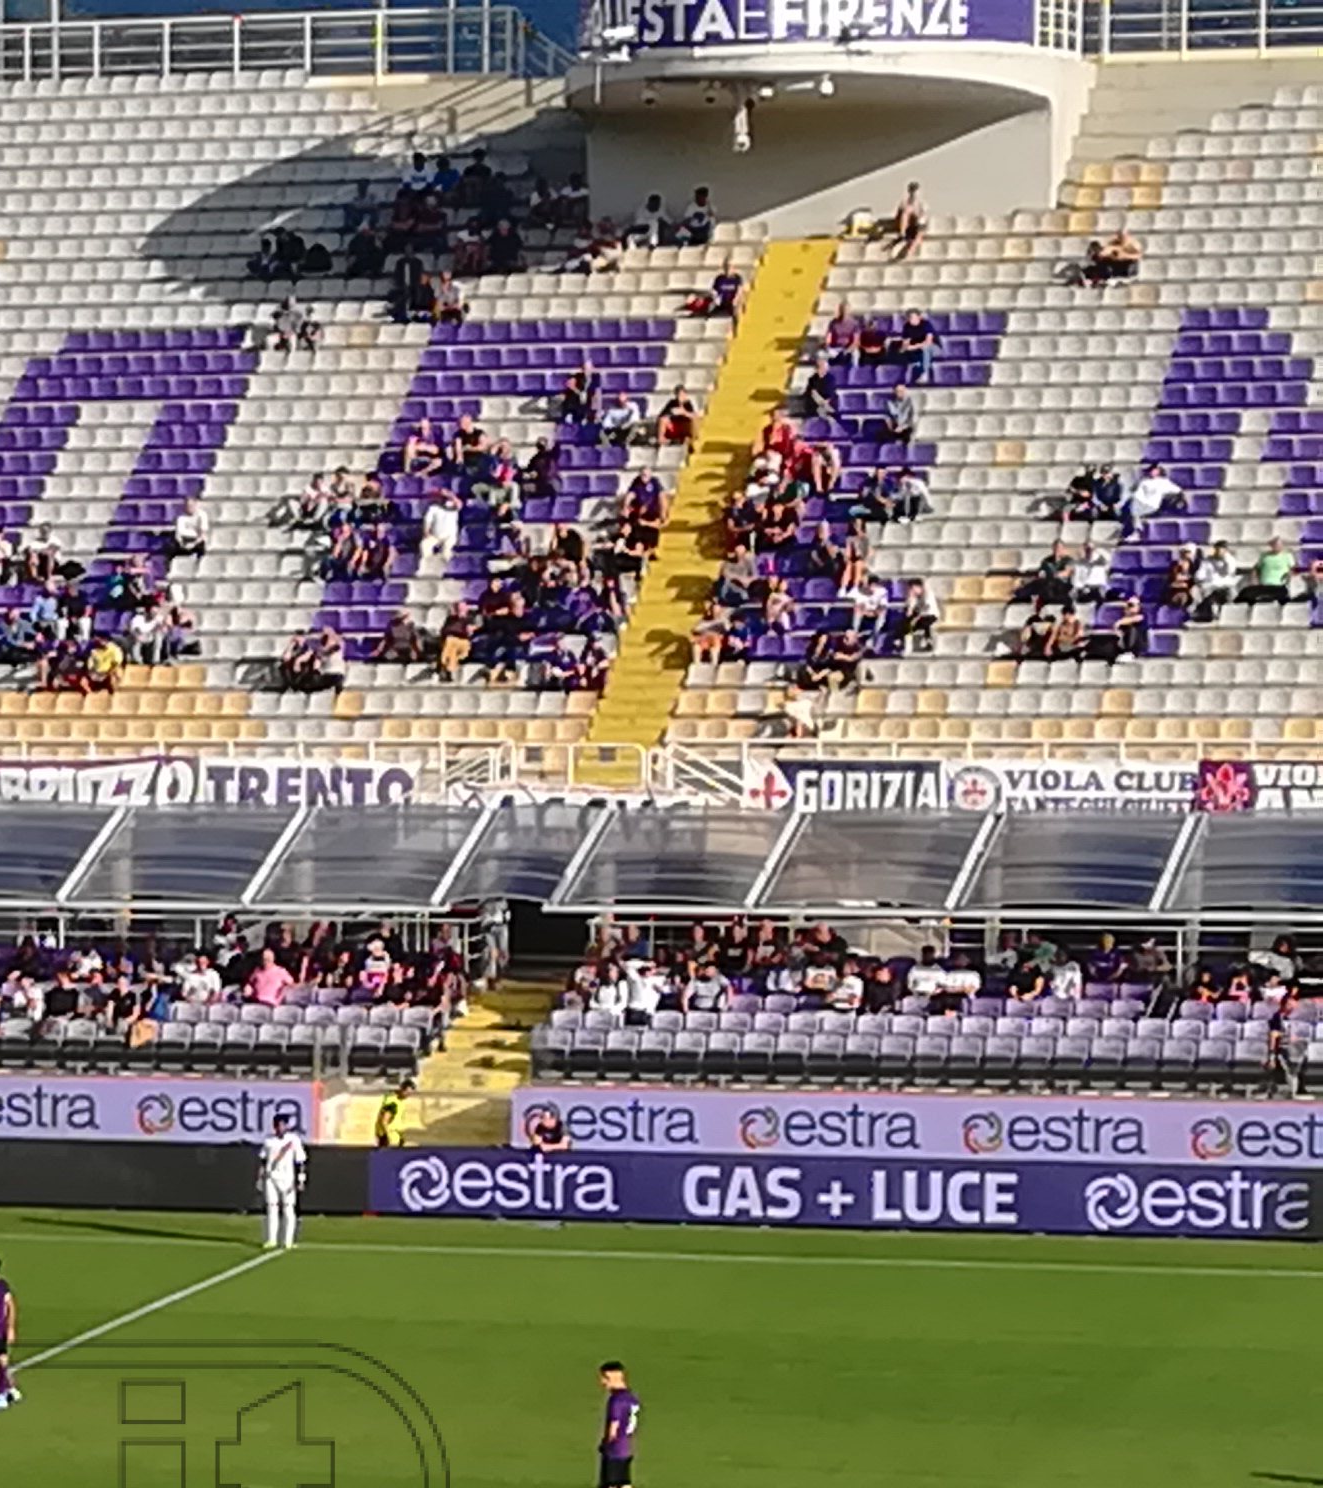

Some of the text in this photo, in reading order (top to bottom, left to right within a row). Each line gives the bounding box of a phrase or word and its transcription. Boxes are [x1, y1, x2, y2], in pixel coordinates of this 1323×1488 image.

[770, 0, 969, 38] FIRENZE
[205, 765, 415, 806] TRENTO
[794, 767, 942, 813] GORIZIA
[1003, 769, 1200, 793] VIOLA CLUB
[565, 1098, 700, 1144] estra
[783, 1102, 921, 1150] estra
[1007, 1107, 1147, 1157] estra
[453, 1153, 620, 1212] estra
[682, 1164, 802, 1218] GAS
[871, 1169, 1019, 1225] LUCE
[1141, 1168, 1312, 1230] estra
